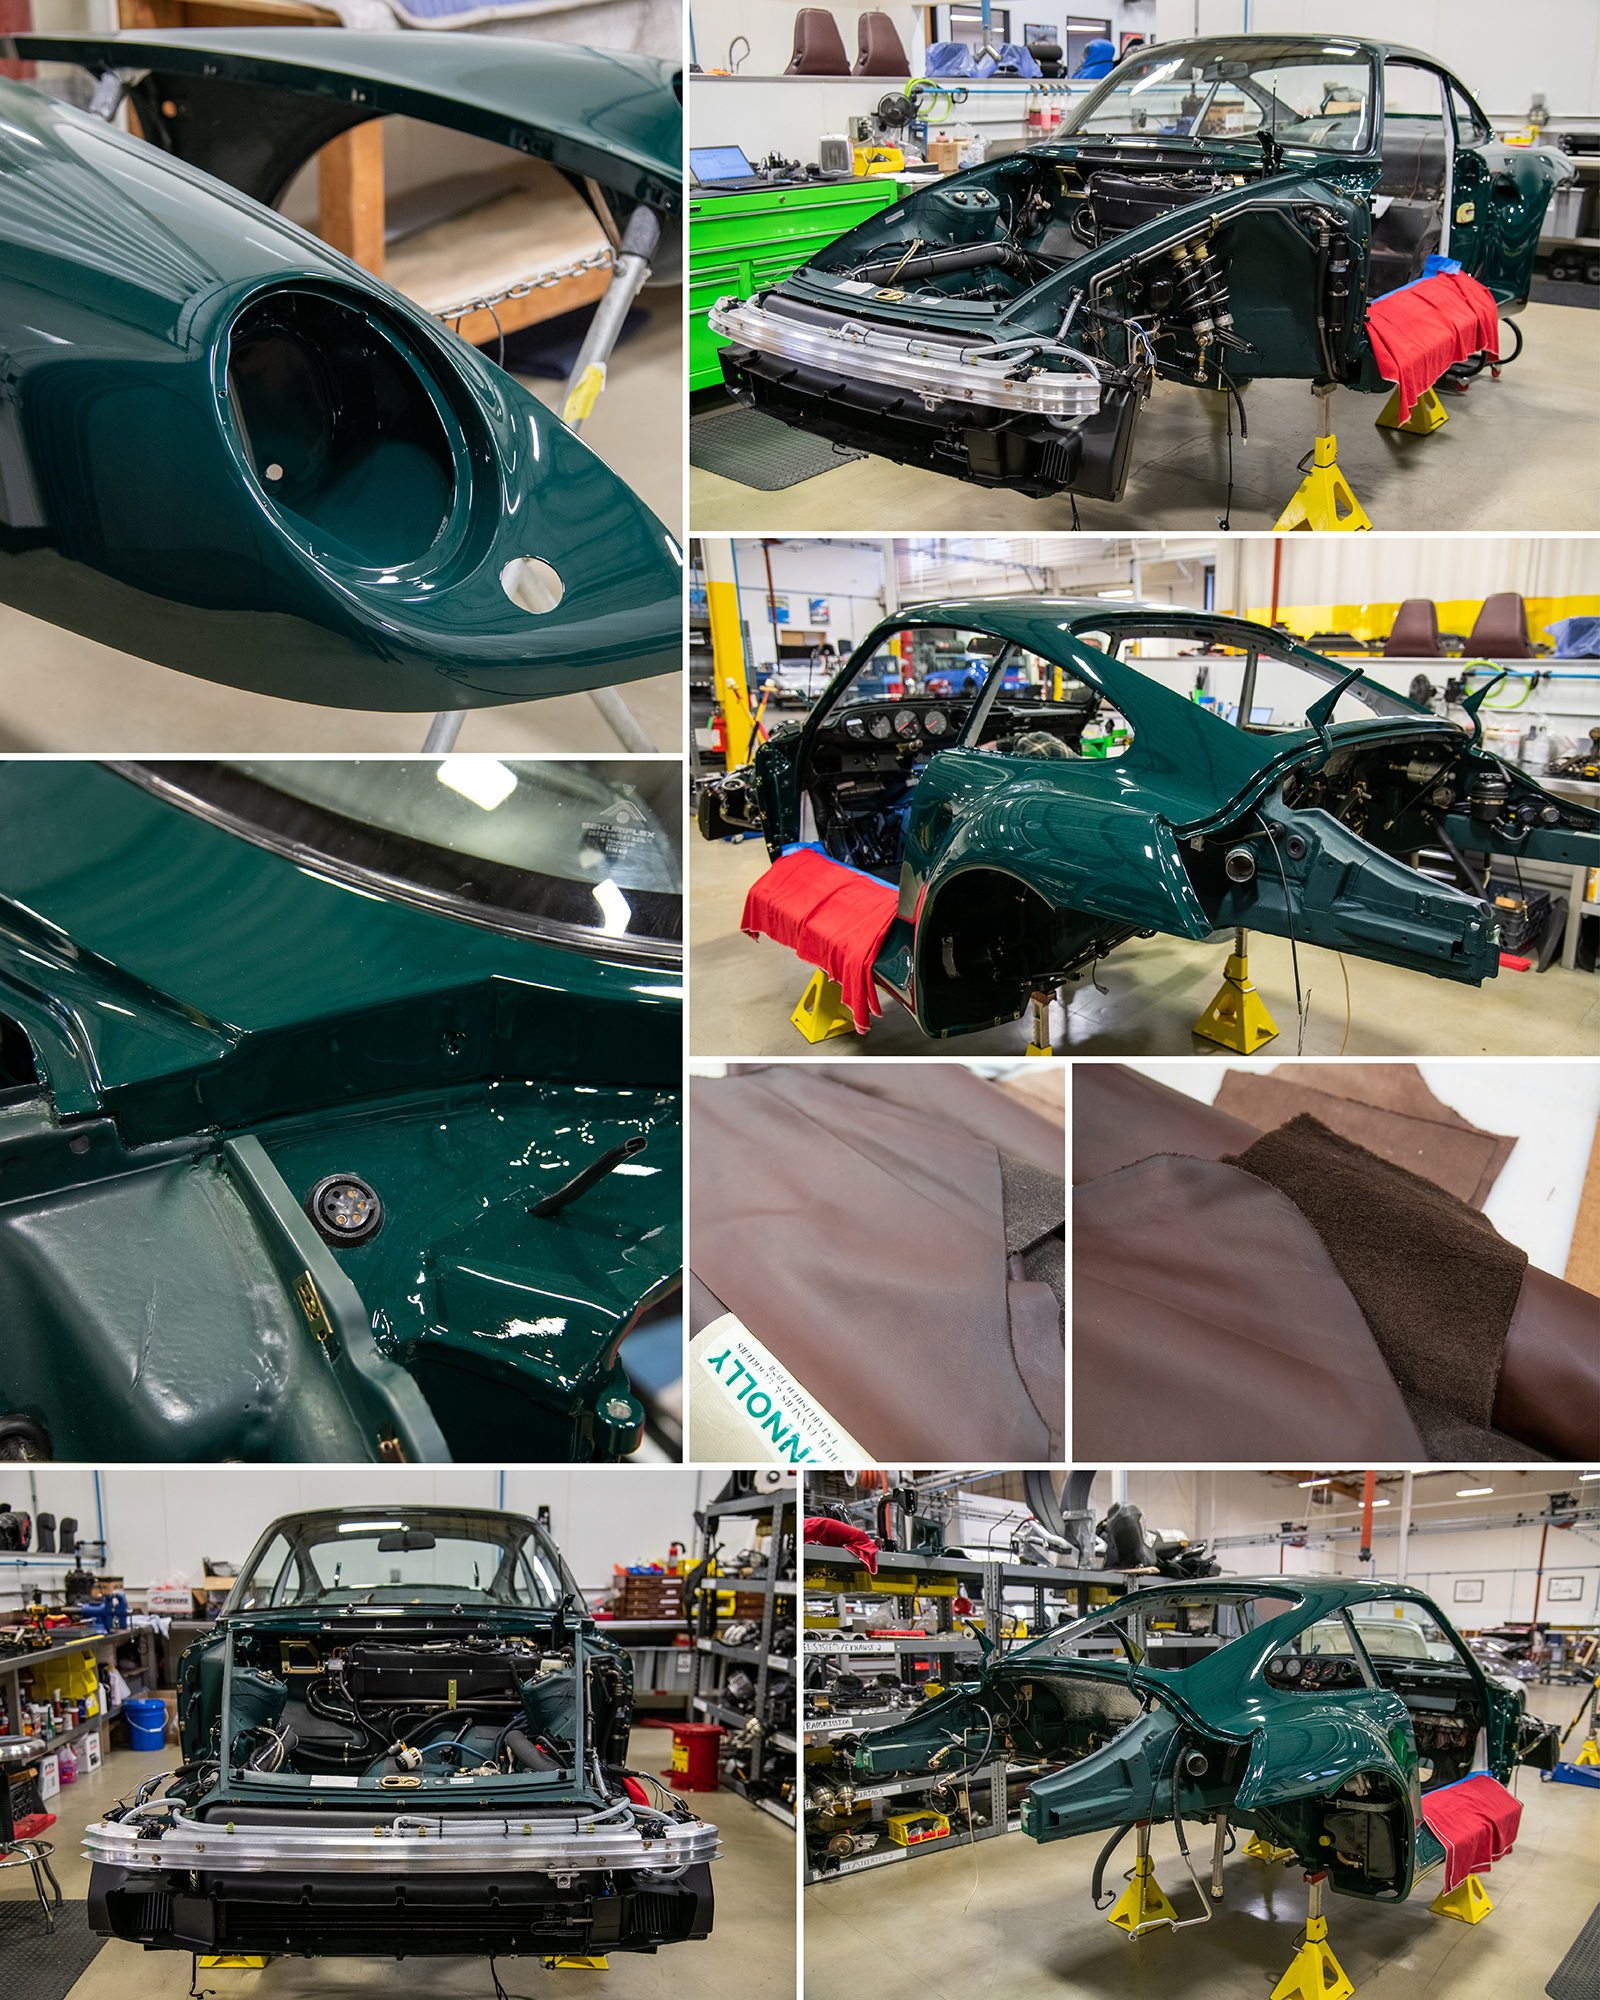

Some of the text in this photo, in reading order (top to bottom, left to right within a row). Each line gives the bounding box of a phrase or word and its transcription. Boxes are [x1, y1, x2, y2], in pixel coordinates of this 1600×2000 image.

[582, 822, 655, 838] SEKURIFLEX
[774, 1386, 782, 1394] &
[780, 1394, 818, 1436] TANNERS
[786, 1386, 838, 1444] ESTABLISHED
[803, 1718, 850, 1730] RANSMISSION
[840, 1853, 888, 1871] XLE/STEERING
